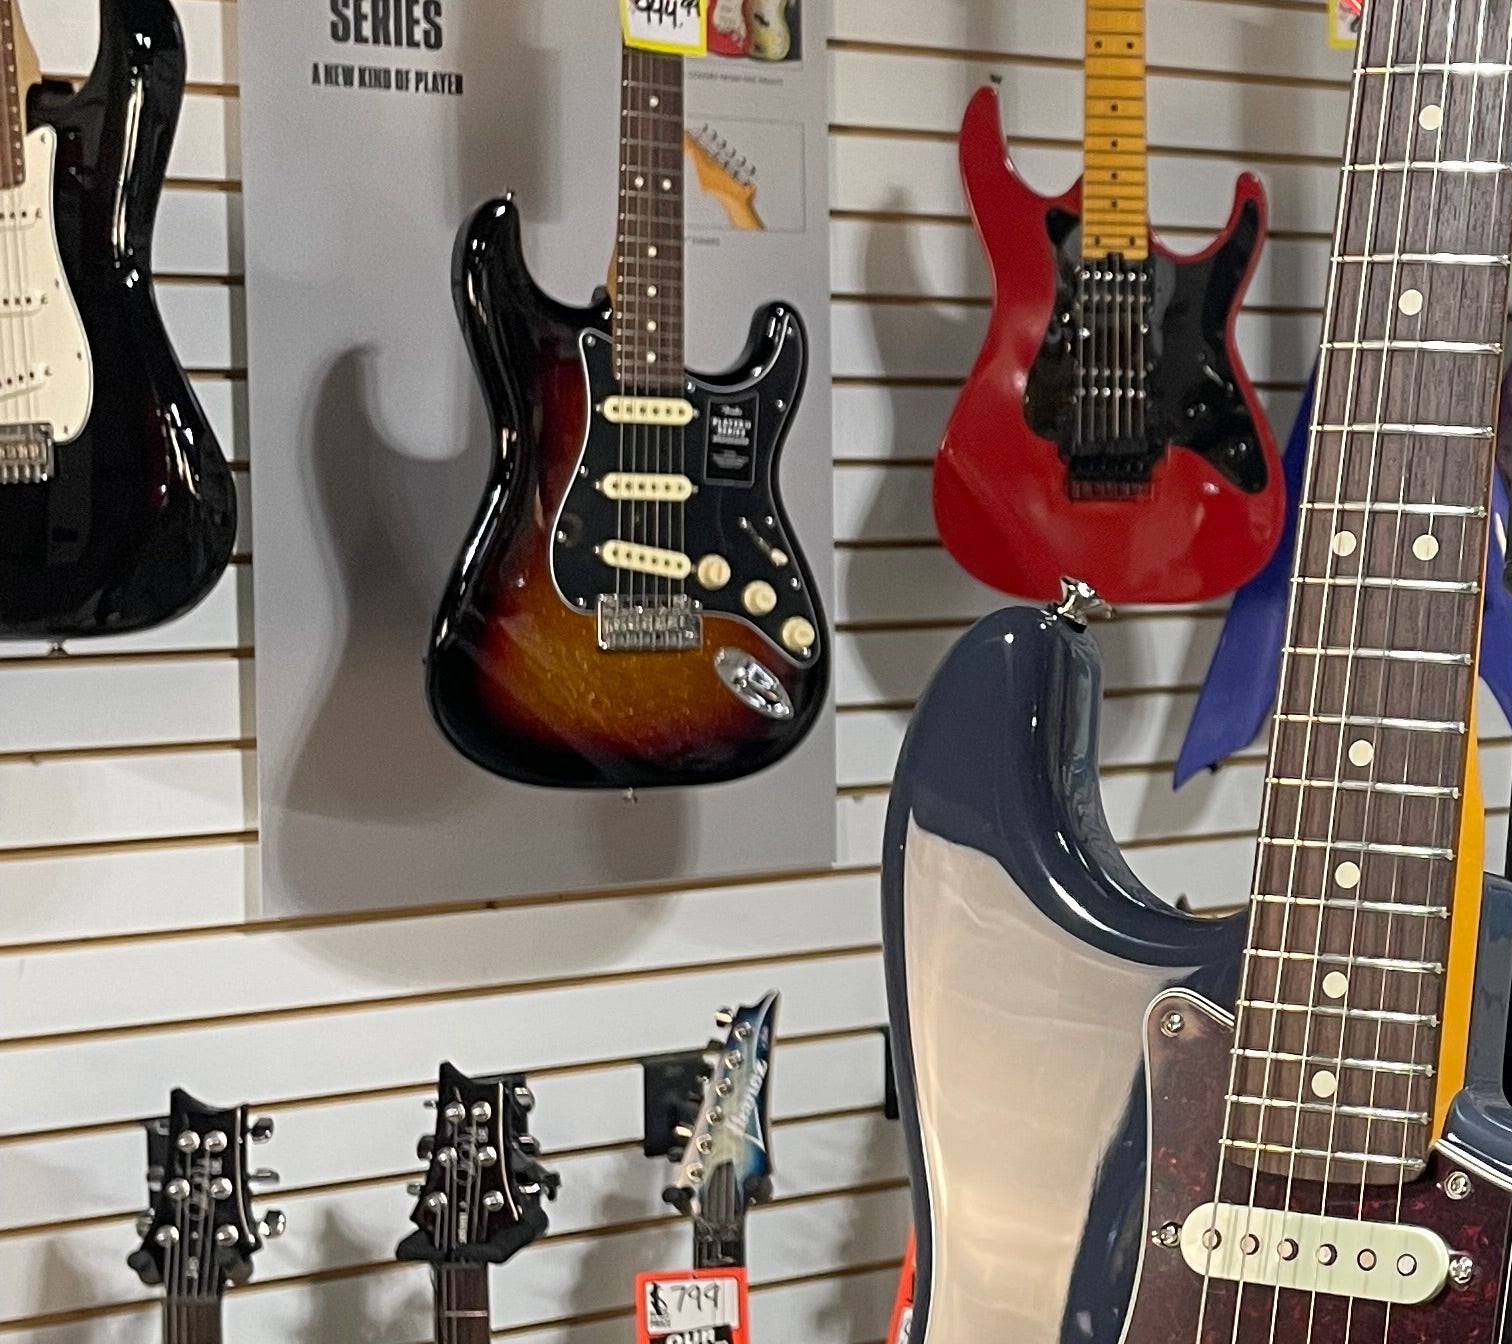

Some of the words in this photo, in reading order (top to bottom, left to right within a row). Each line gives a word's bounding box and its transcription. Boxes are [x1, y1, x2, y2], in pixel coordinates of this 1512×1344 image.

[311, 62, 322, 87] A
[324, 63, 355, 89] NEW
[357, 65, 392, 92] KIND
[394, 67, 412, 93] OF
[414, 69, 464, 96] PLAYER
